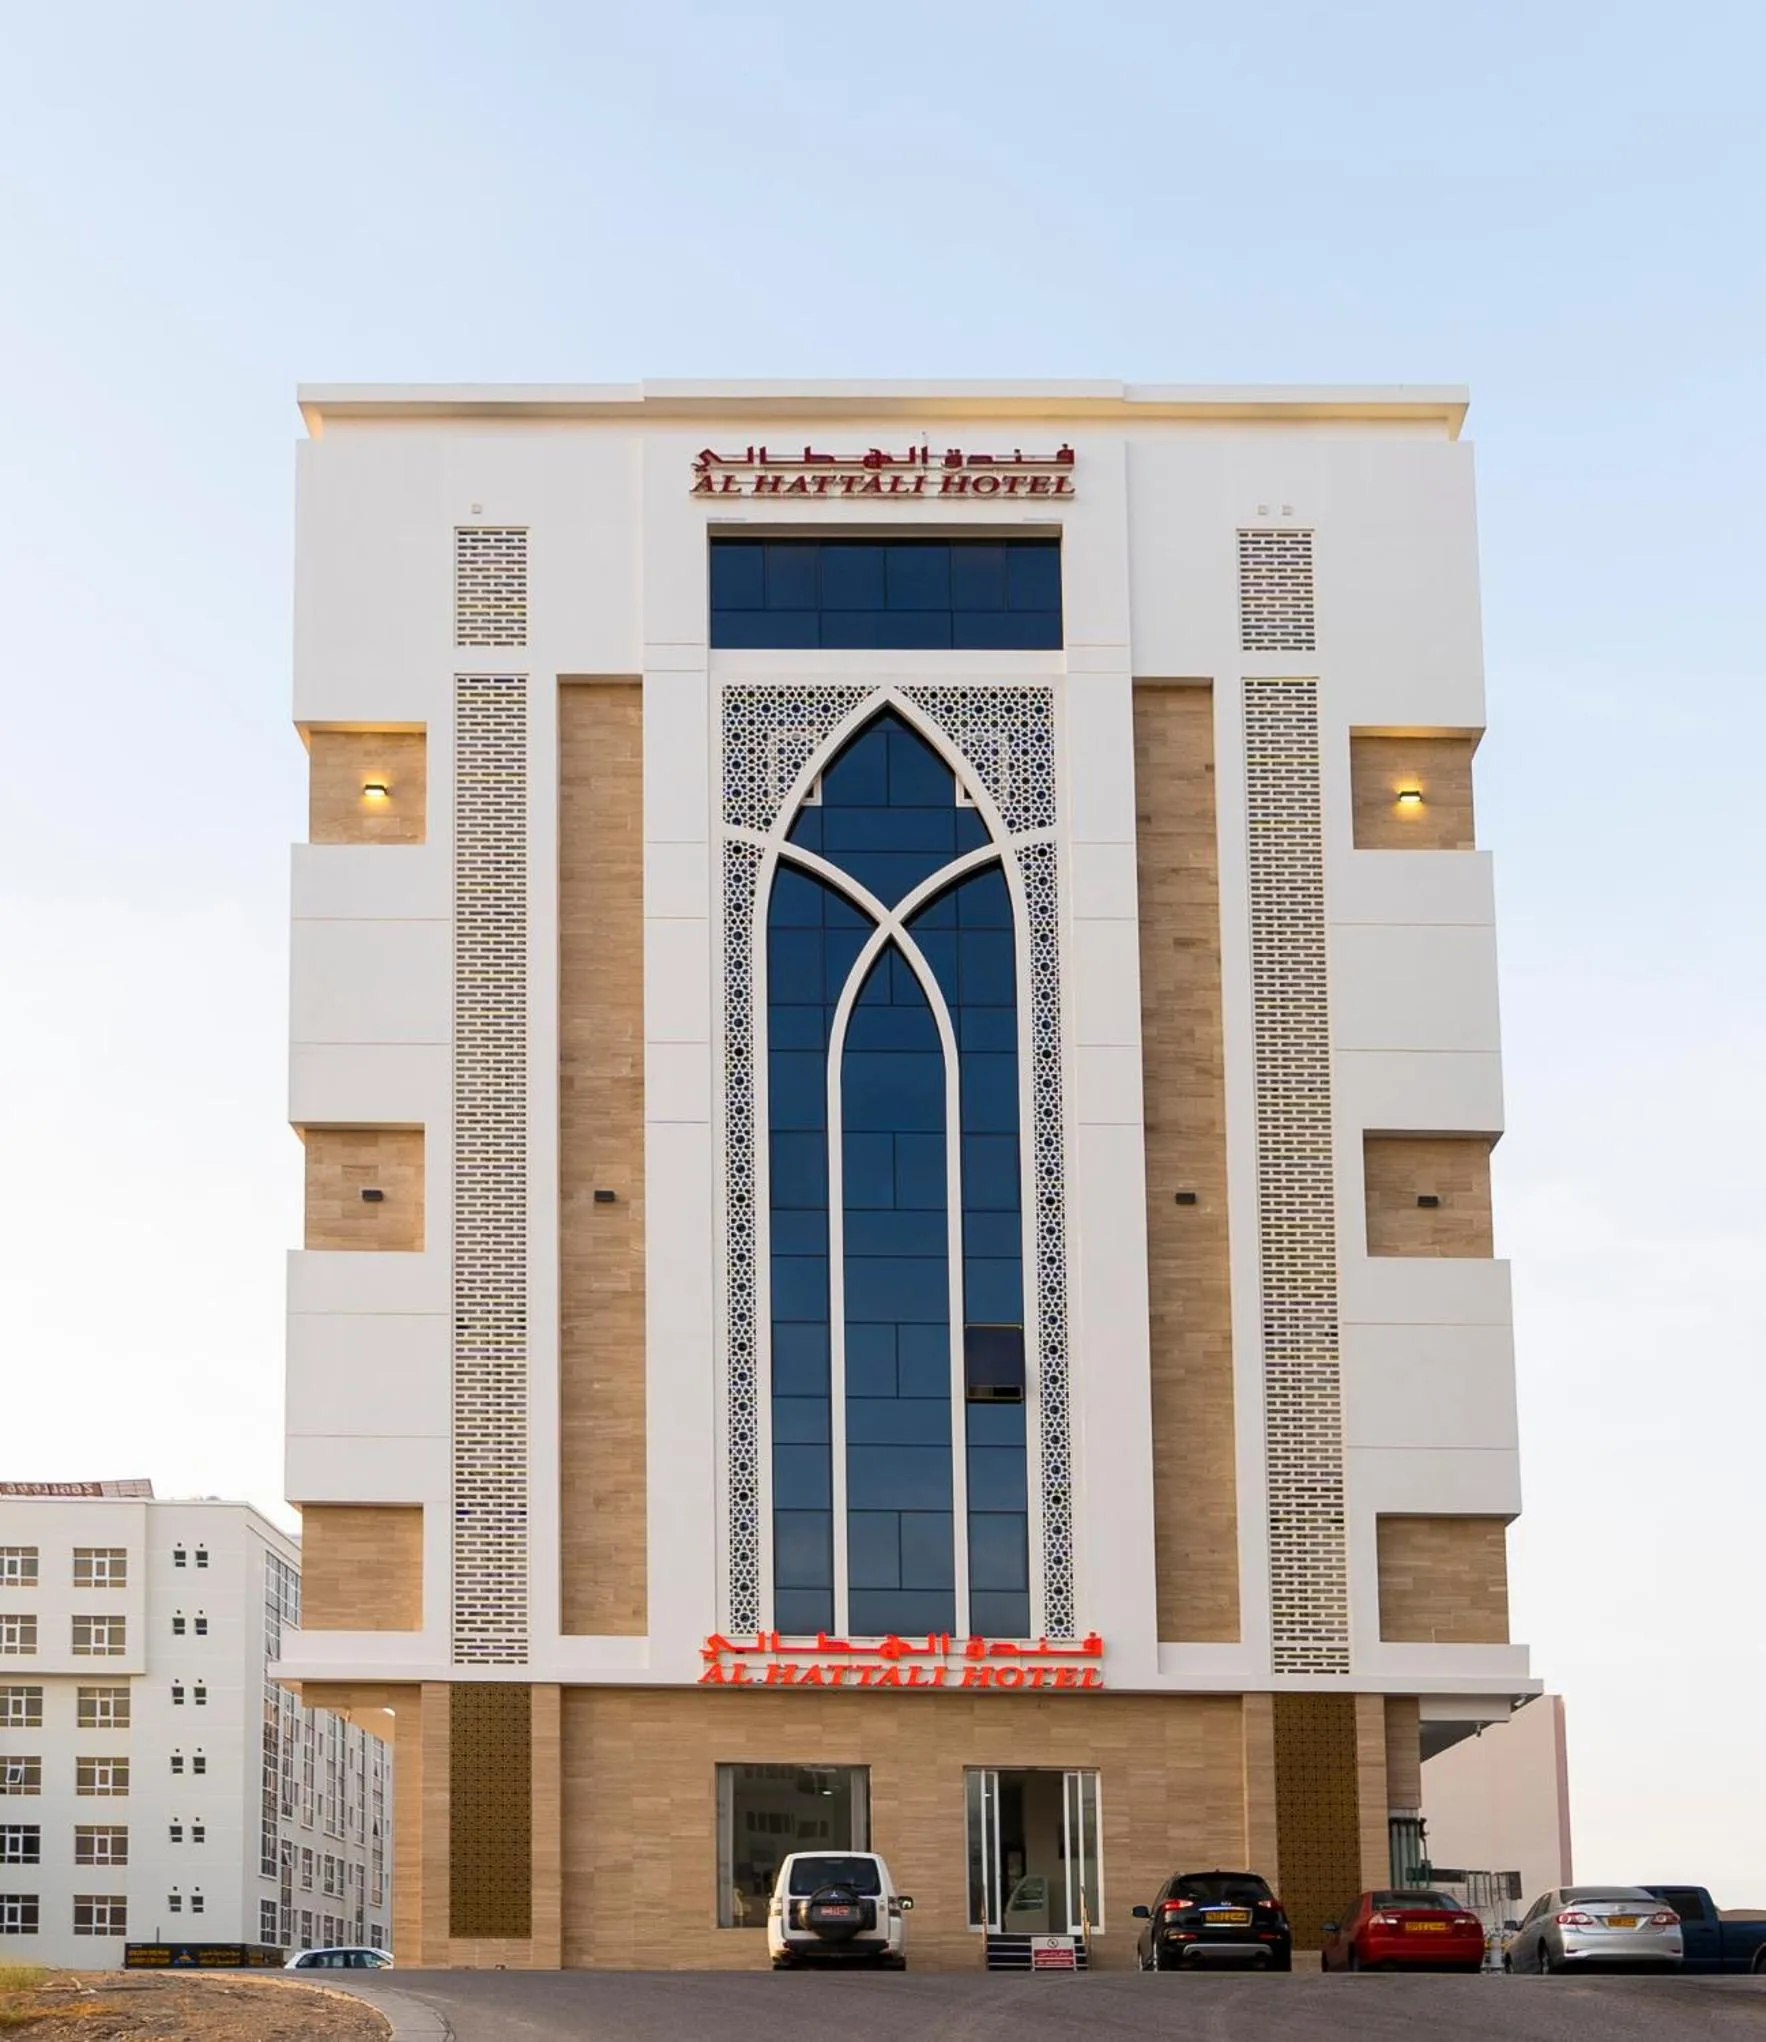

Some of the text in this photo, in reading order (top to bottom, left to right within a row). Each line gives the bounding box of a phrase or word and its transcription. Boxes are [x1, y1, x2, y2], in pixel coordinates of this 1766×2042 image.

[941, 443, 1075, 471] فندق
[690, 474, 1076, 494] AL HATTALI HOTEL
[964, 1632, 1104, 1661] فندق
[698, 1662, 1104, 1688] AL HATTALI HOTEL
